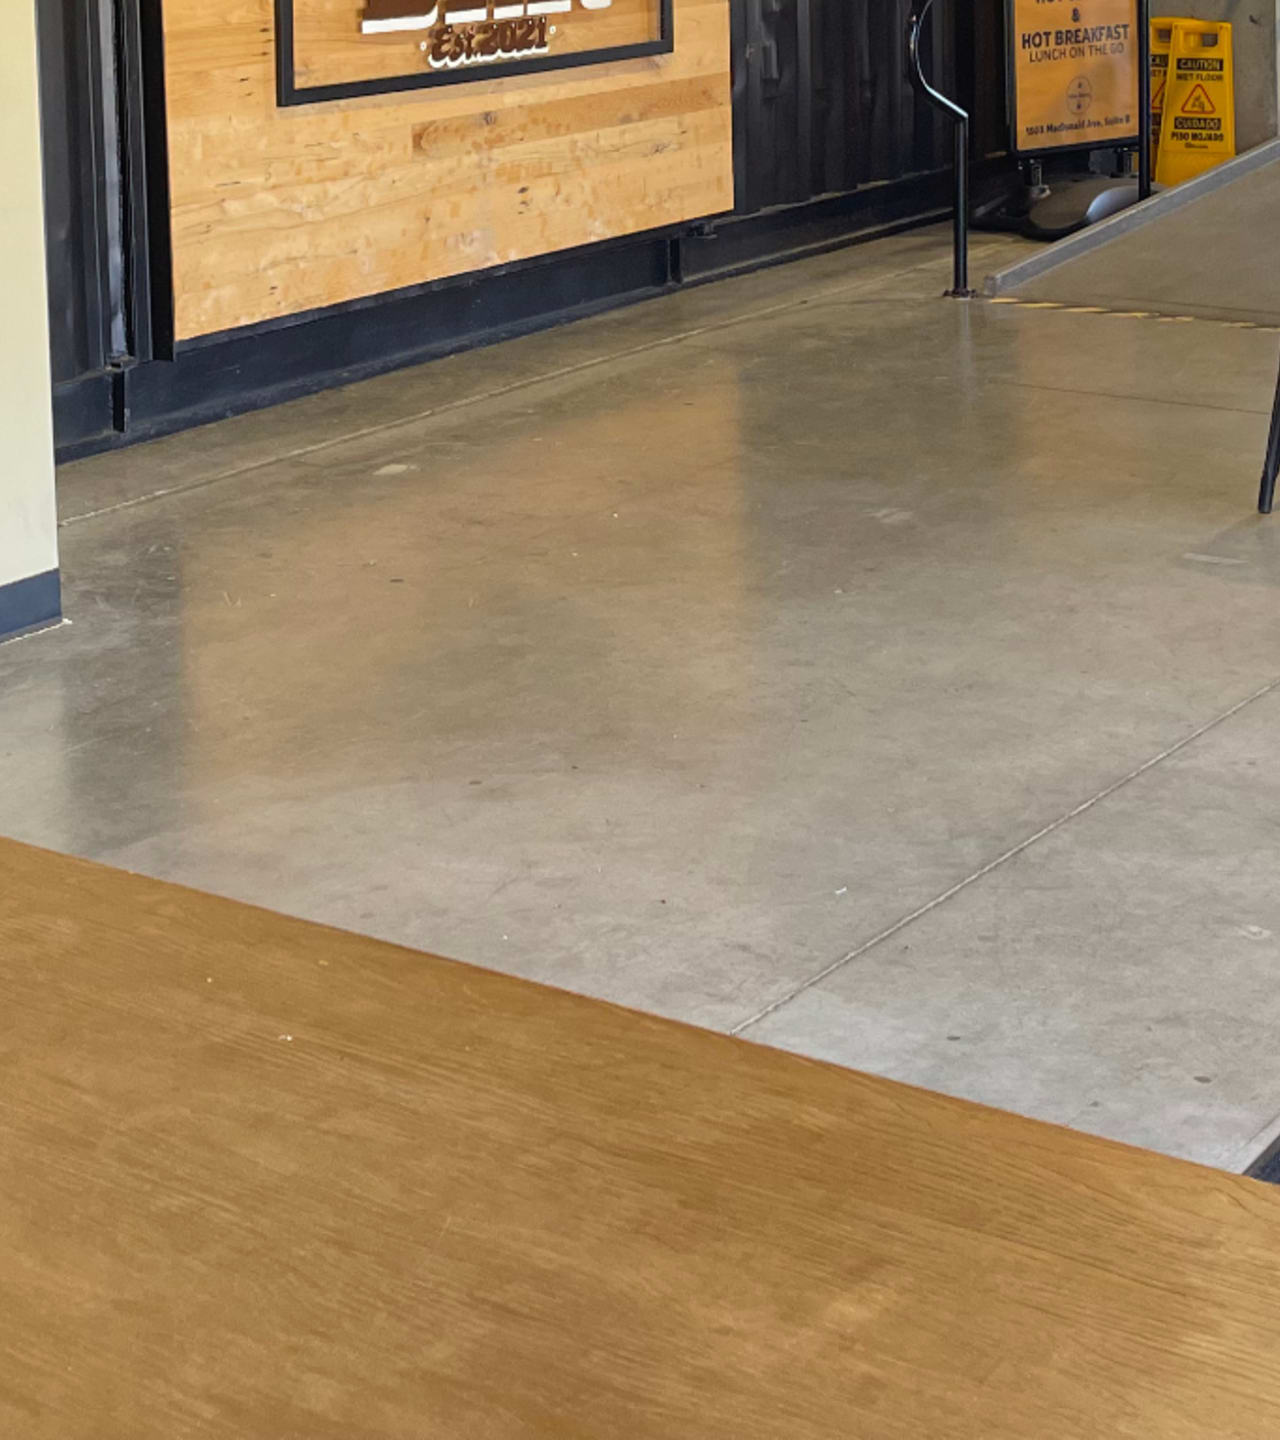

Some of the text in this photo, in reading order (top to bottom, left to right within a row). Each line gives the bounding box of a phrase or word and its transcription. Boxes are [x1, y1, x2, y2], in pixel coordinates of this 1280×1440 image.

[1021, 23, 1129, 50] HOT BREAKFAST
[1029, 42, 1125, 63] LUNCH ON THE GO
[1179, 59, 1221, 71] CAUTION
[1176, 72, 1194, 82] WET
[1196, 72, 1224, 82] FLOOR
[1175, 117, 1219, 130] CUIDADO
[1170, 131, 1190, 142] PISO
